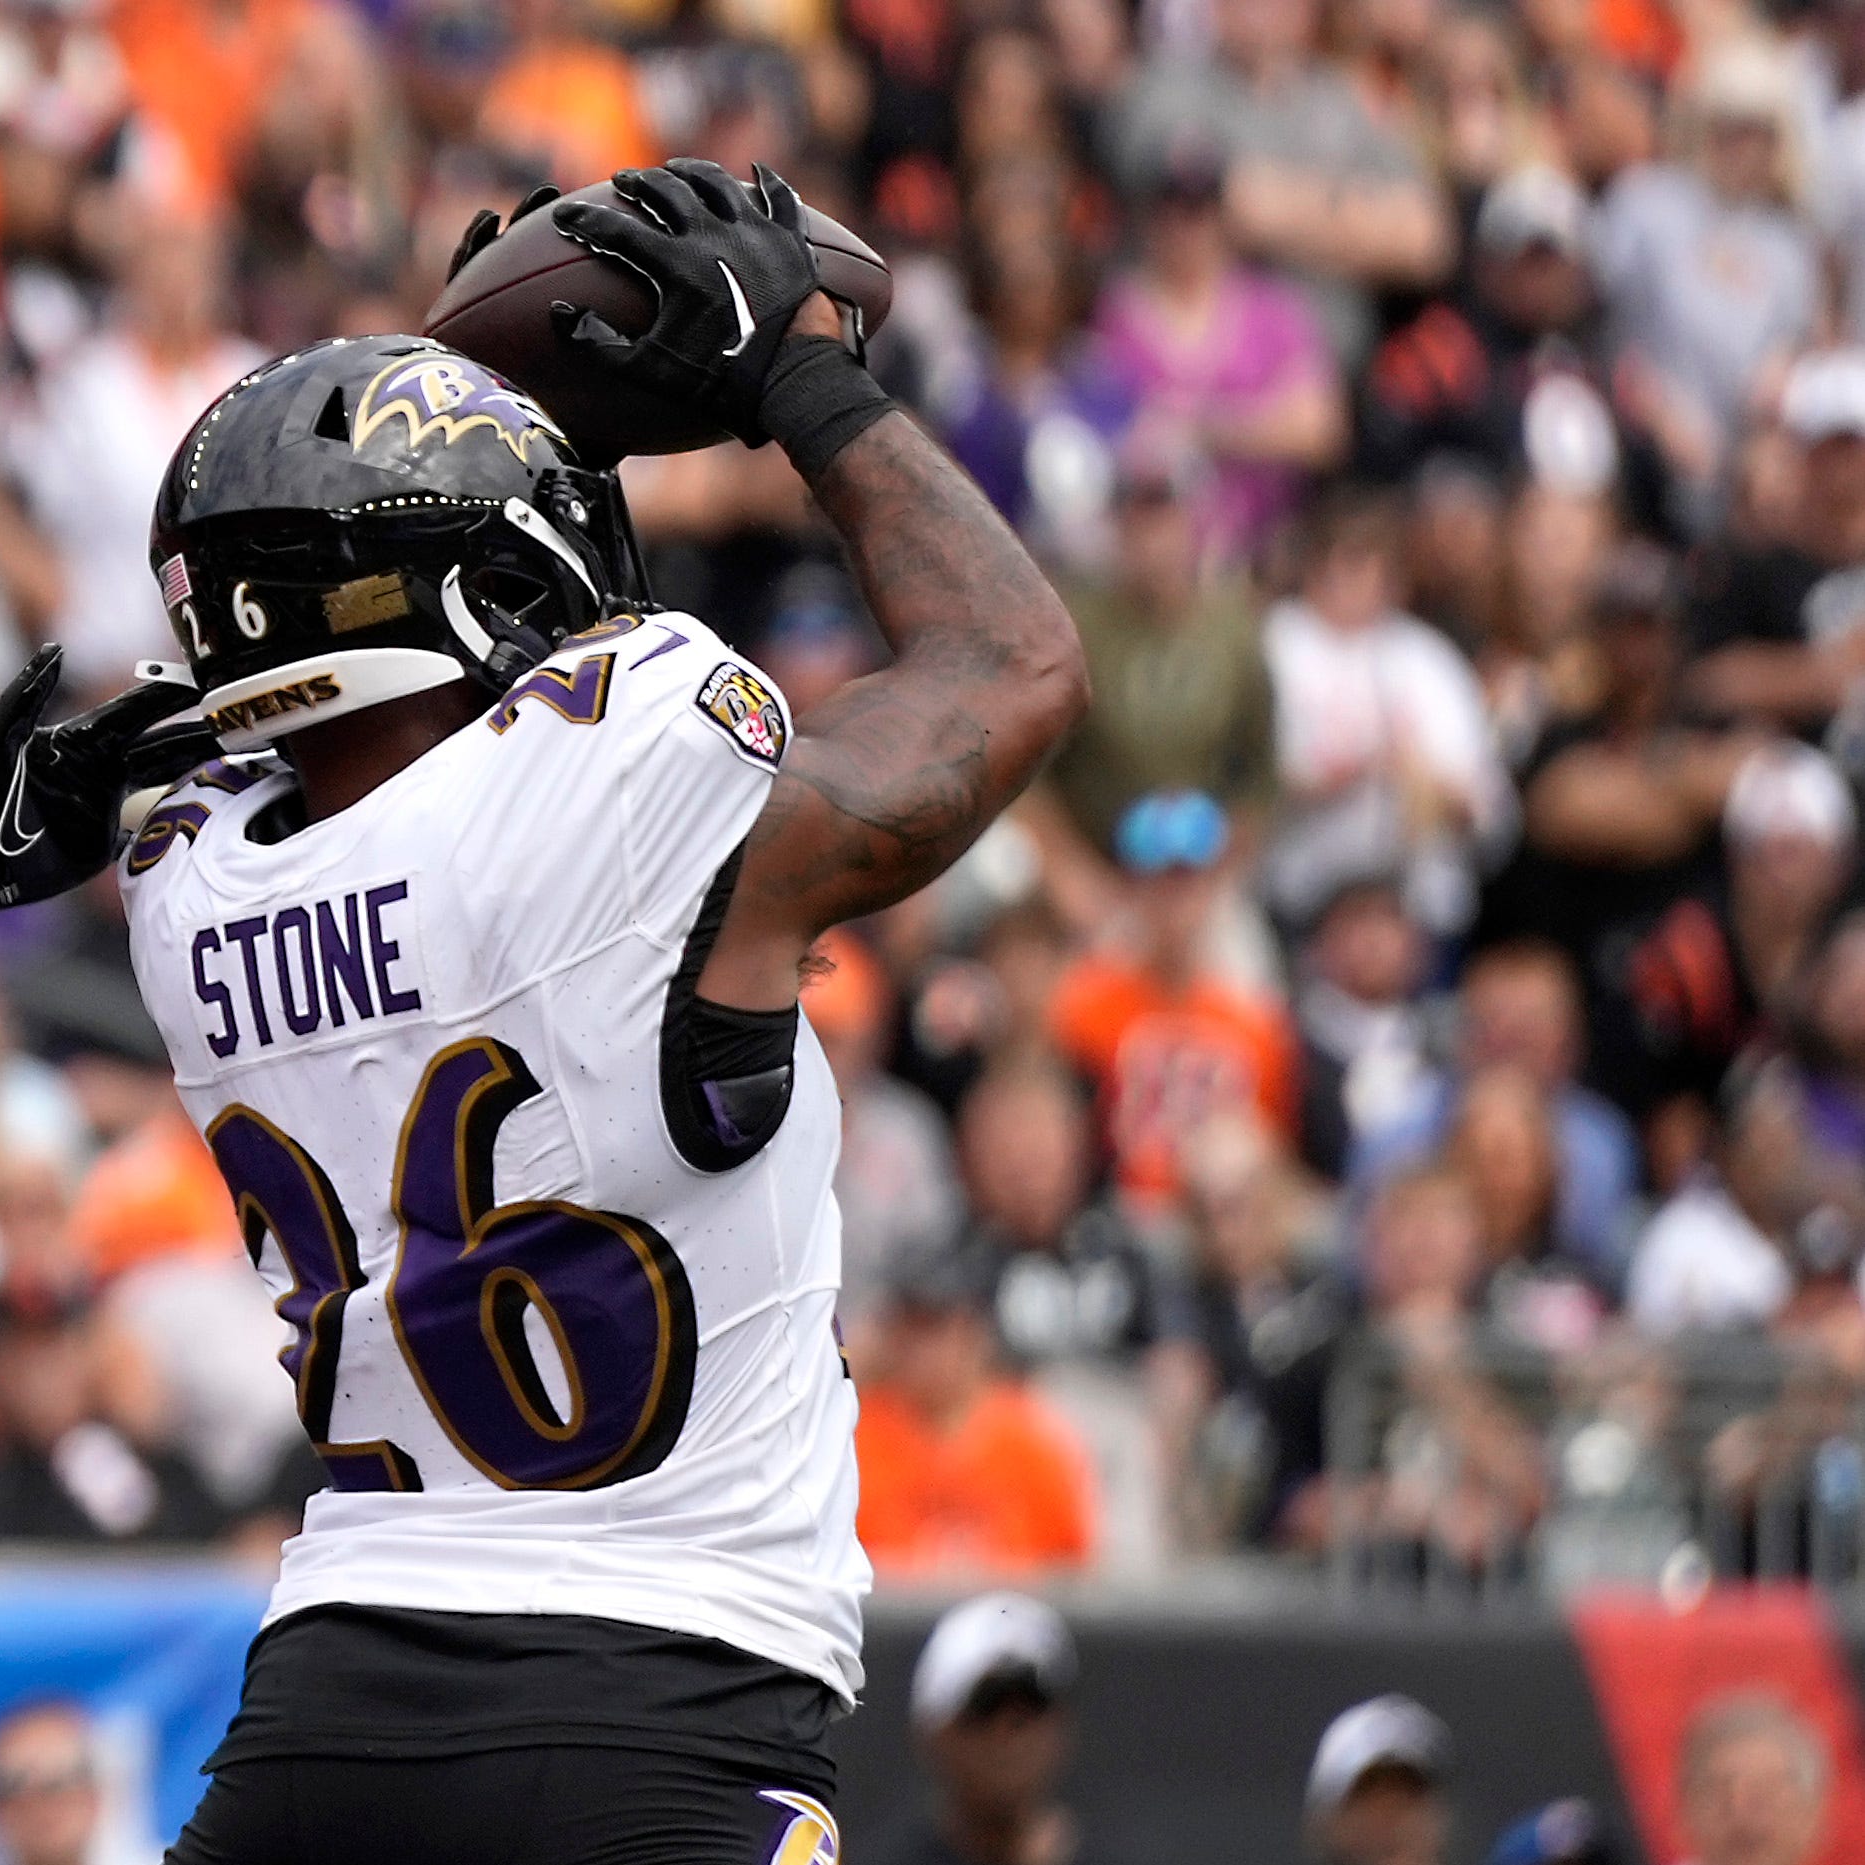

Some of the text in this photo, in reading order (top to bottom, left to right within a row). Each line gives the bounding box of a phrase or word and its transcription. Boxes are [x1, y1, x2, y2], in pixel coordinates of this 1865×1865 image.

[180, 580, 268, 661] 26
[205, 672, 343, 736] AVENS
[191, 880, 421, 1058] STONE
[205, 1036, 698, 1492] 26
